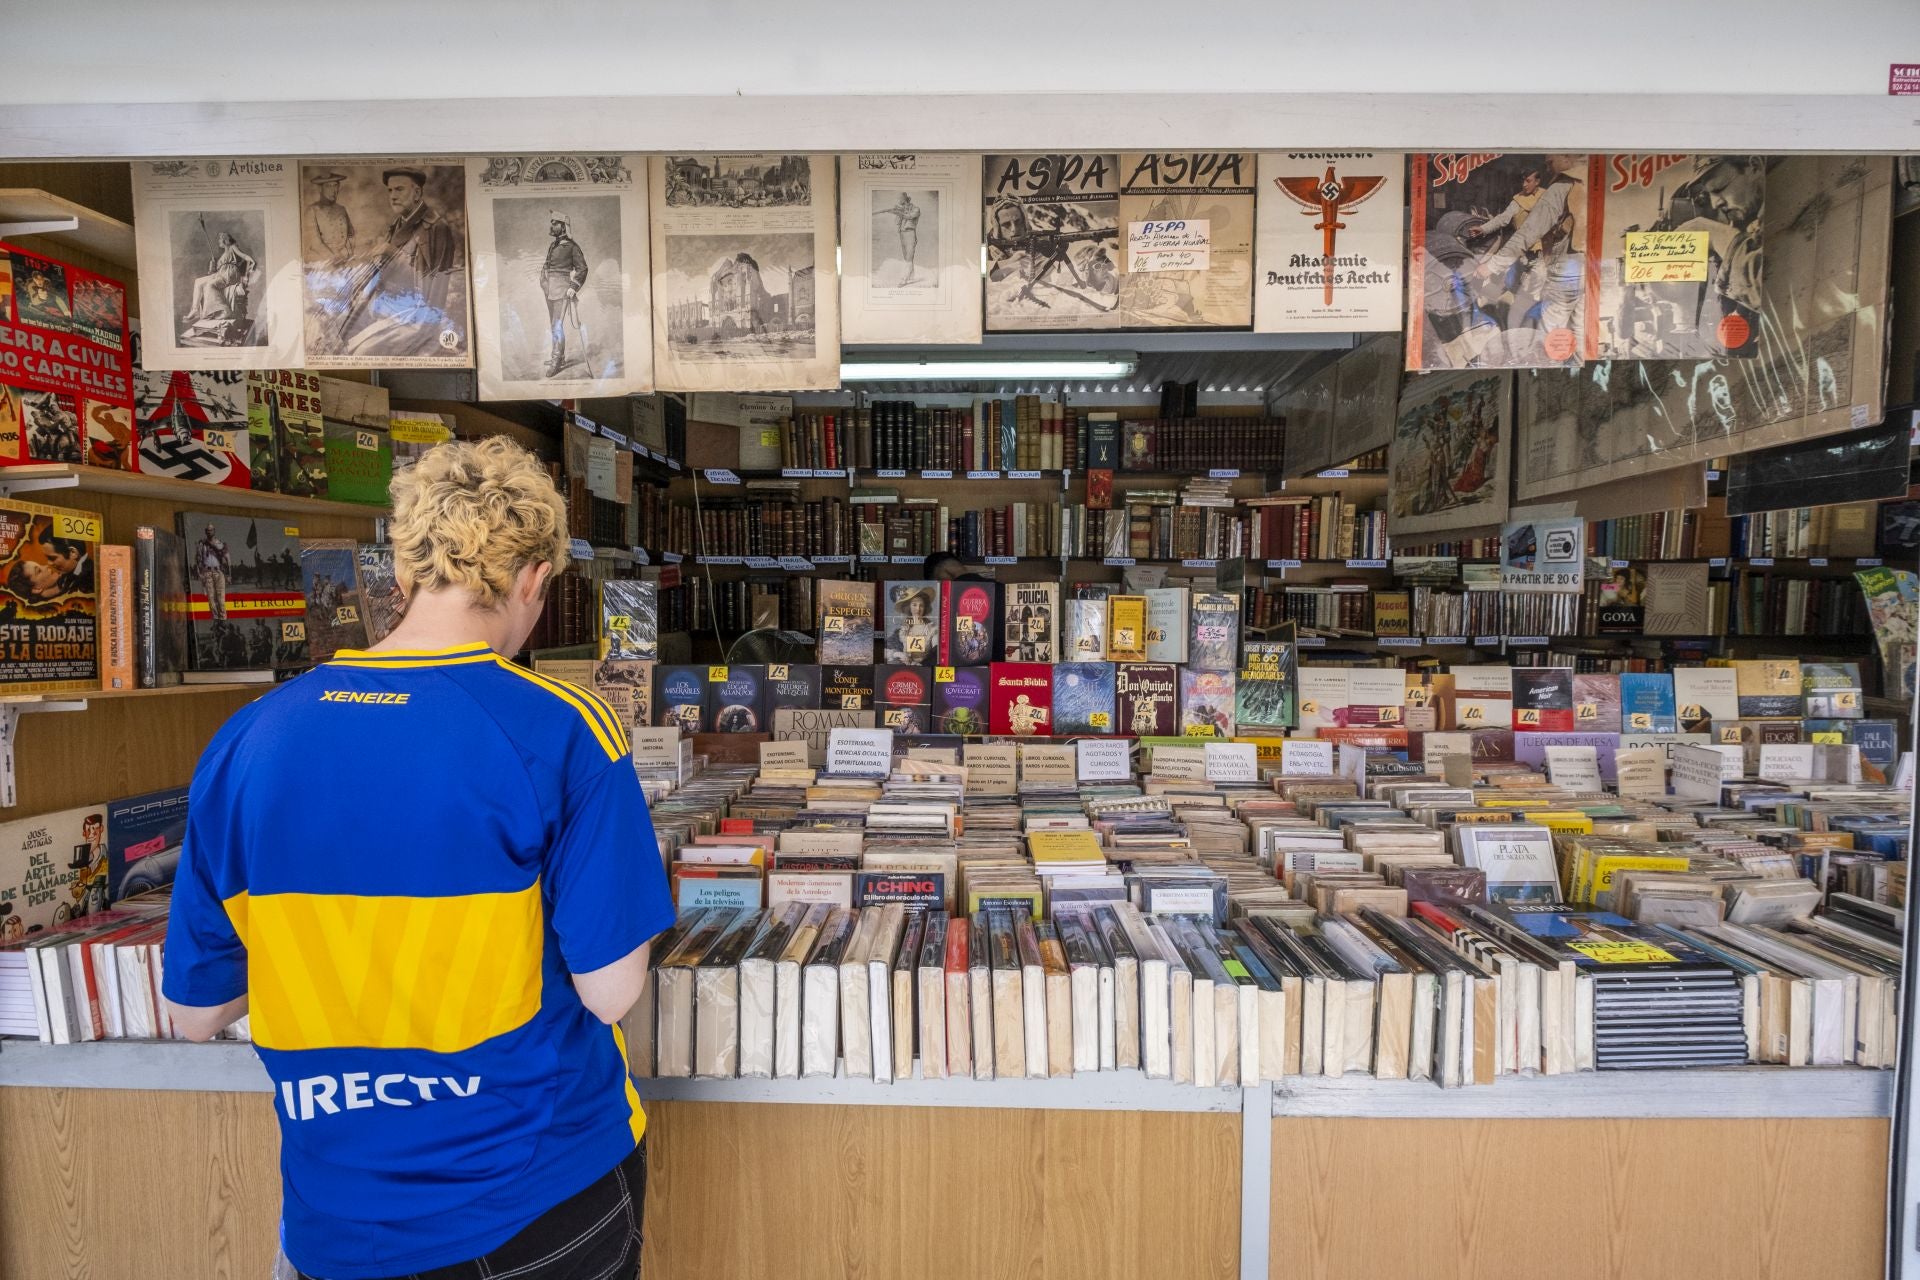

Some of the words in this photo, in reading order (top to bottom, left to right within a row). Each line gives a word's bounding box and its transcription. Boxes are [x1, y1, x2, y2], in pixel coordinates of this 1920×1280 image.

[997, 155, 1109, 193] ASPA
[1126, 154, 1243, 188] ASPA
[1143, 221, 1186, 234] ASPA
[1289, 254, 1368, 268] Akademie
[1346, 270, 1391, 285] Recht
[94, 327, 121, 343] MADRID
[67, 344, 121, 372] CIVIL
[23, 355, 127, 393] CARTELES
[62, 382, 82, 392] CIVIL
[249, 385, 322, 415] IONES
[62, 518, 95, 537] 30€
[1502, 575, 1508, 584] A
[1510, 574, 1541, 584] PARTIR
[1543, 574, 1556, 584] DE
[1557, 574, 1570, 584] 20
[1571, 574, 1579, 584] €
[830, 592, 867, 601] ORIGEN
[234, 598, 248, 608] EL
[253, 597, 295, 608] TERCIO
[830, 607, 871, 617] ESPECIES
[1602, 612, 1637, 623] GOYA
[37, 625, 94, 642] RODAJE
[10, 644, 32, 661] LA
[35, 643, 95, 660] GUERRA!
[1248, 654, 1261, 662] MIS
[1263, 653, 1279, 662] 60
[1248, 663, 1279, 671] PARTIDAS
[834, 676, 859, 684] CONDE
[1241, 671, 1285, 681] MEMORABLES
[892, 681, 918, 690] CRIMEN
[998, 677, 1023, 687] Santa
[1023, 677, 1048, 687] Biblia
[1117, 671, 1140, 694] Don
[1140, 679, 1173, 693] Quijote
[664, 687, 700, 696] MISERABLES
[825, 687, 873, 696] MONTECRISTO
[945, 687, 982, 696] LOVECRAFT
[1528, 685, 1559, 696] American
[319, 690, 411, 704] XENEIZE
[1538, 692, 1553, 701] Noir
[792, 711, 862, 730] ROMAN
[1523, 737, 1563, 747] JUEGOS
[1566, 737, 1580, 746] DE
[1584, 736, 1614, 746] MESA
[1765, 733, 1795, 742] EDGAR
[861, 750, 890, 758] OCULTAS,
[834, 760, 883, 768] ESPIRITUALIDAD,
[1375, 764, 1386, 772] El
[1387, 764, 1423, 772] Cubismo
[22, 836, 53, 851] ARTIGAS
[1500, 845, 1529, 854] PLATA
[30, 852, 50, 867] DEL
[25, 864, 56, 882] ARTE
[2, 887, 17, 901] DE
[22, 870, 80, 896] LLAMARSE
[868, 881, 873, 893] I
[876, 881, 935, 893] CHING
[29, 889, 57, 907] PEPE
[700, 888, 712, 896] Los
[713, 888, 741, 897] peligros
[281, 1071, 481, 1121] IRECTV
